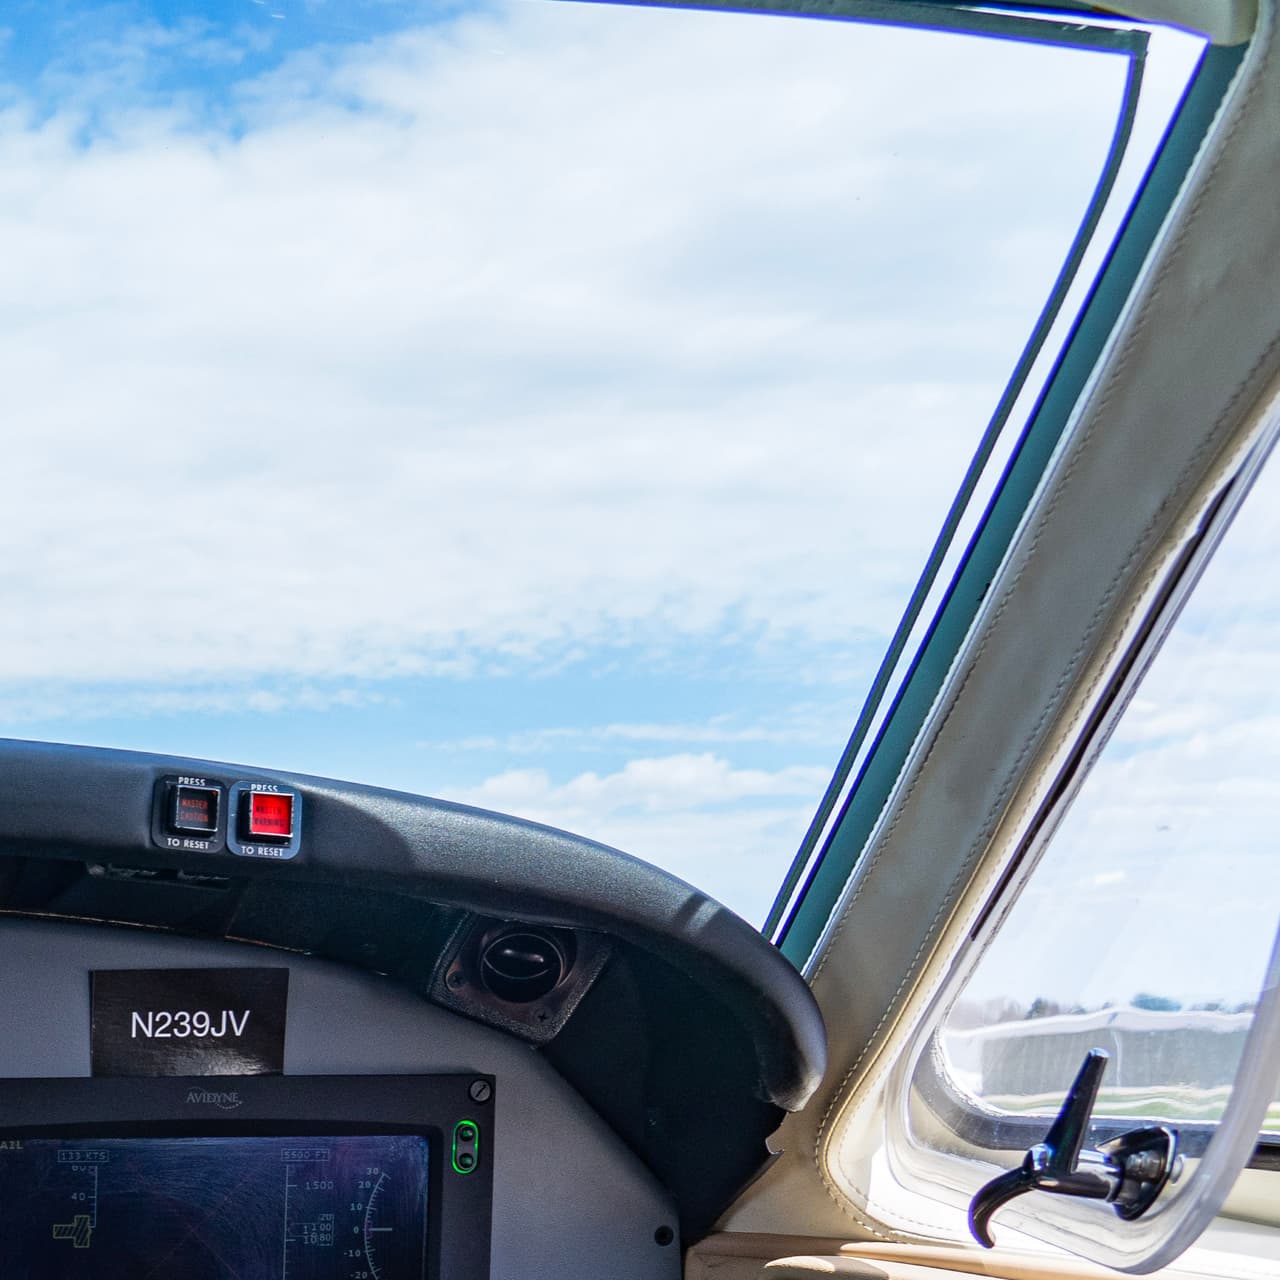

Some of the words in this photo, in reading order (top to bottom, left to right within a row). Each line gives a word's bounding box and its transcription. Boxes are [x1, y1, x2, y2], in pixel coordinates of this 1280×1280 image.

[167, 838, 180, 846] TO
[184, 839, 209, 849] RESET
[241, 846, 254, 855] TO
[258, 847, 284, 857] RESET
[131, 1010, 250, 1038] N239JV
